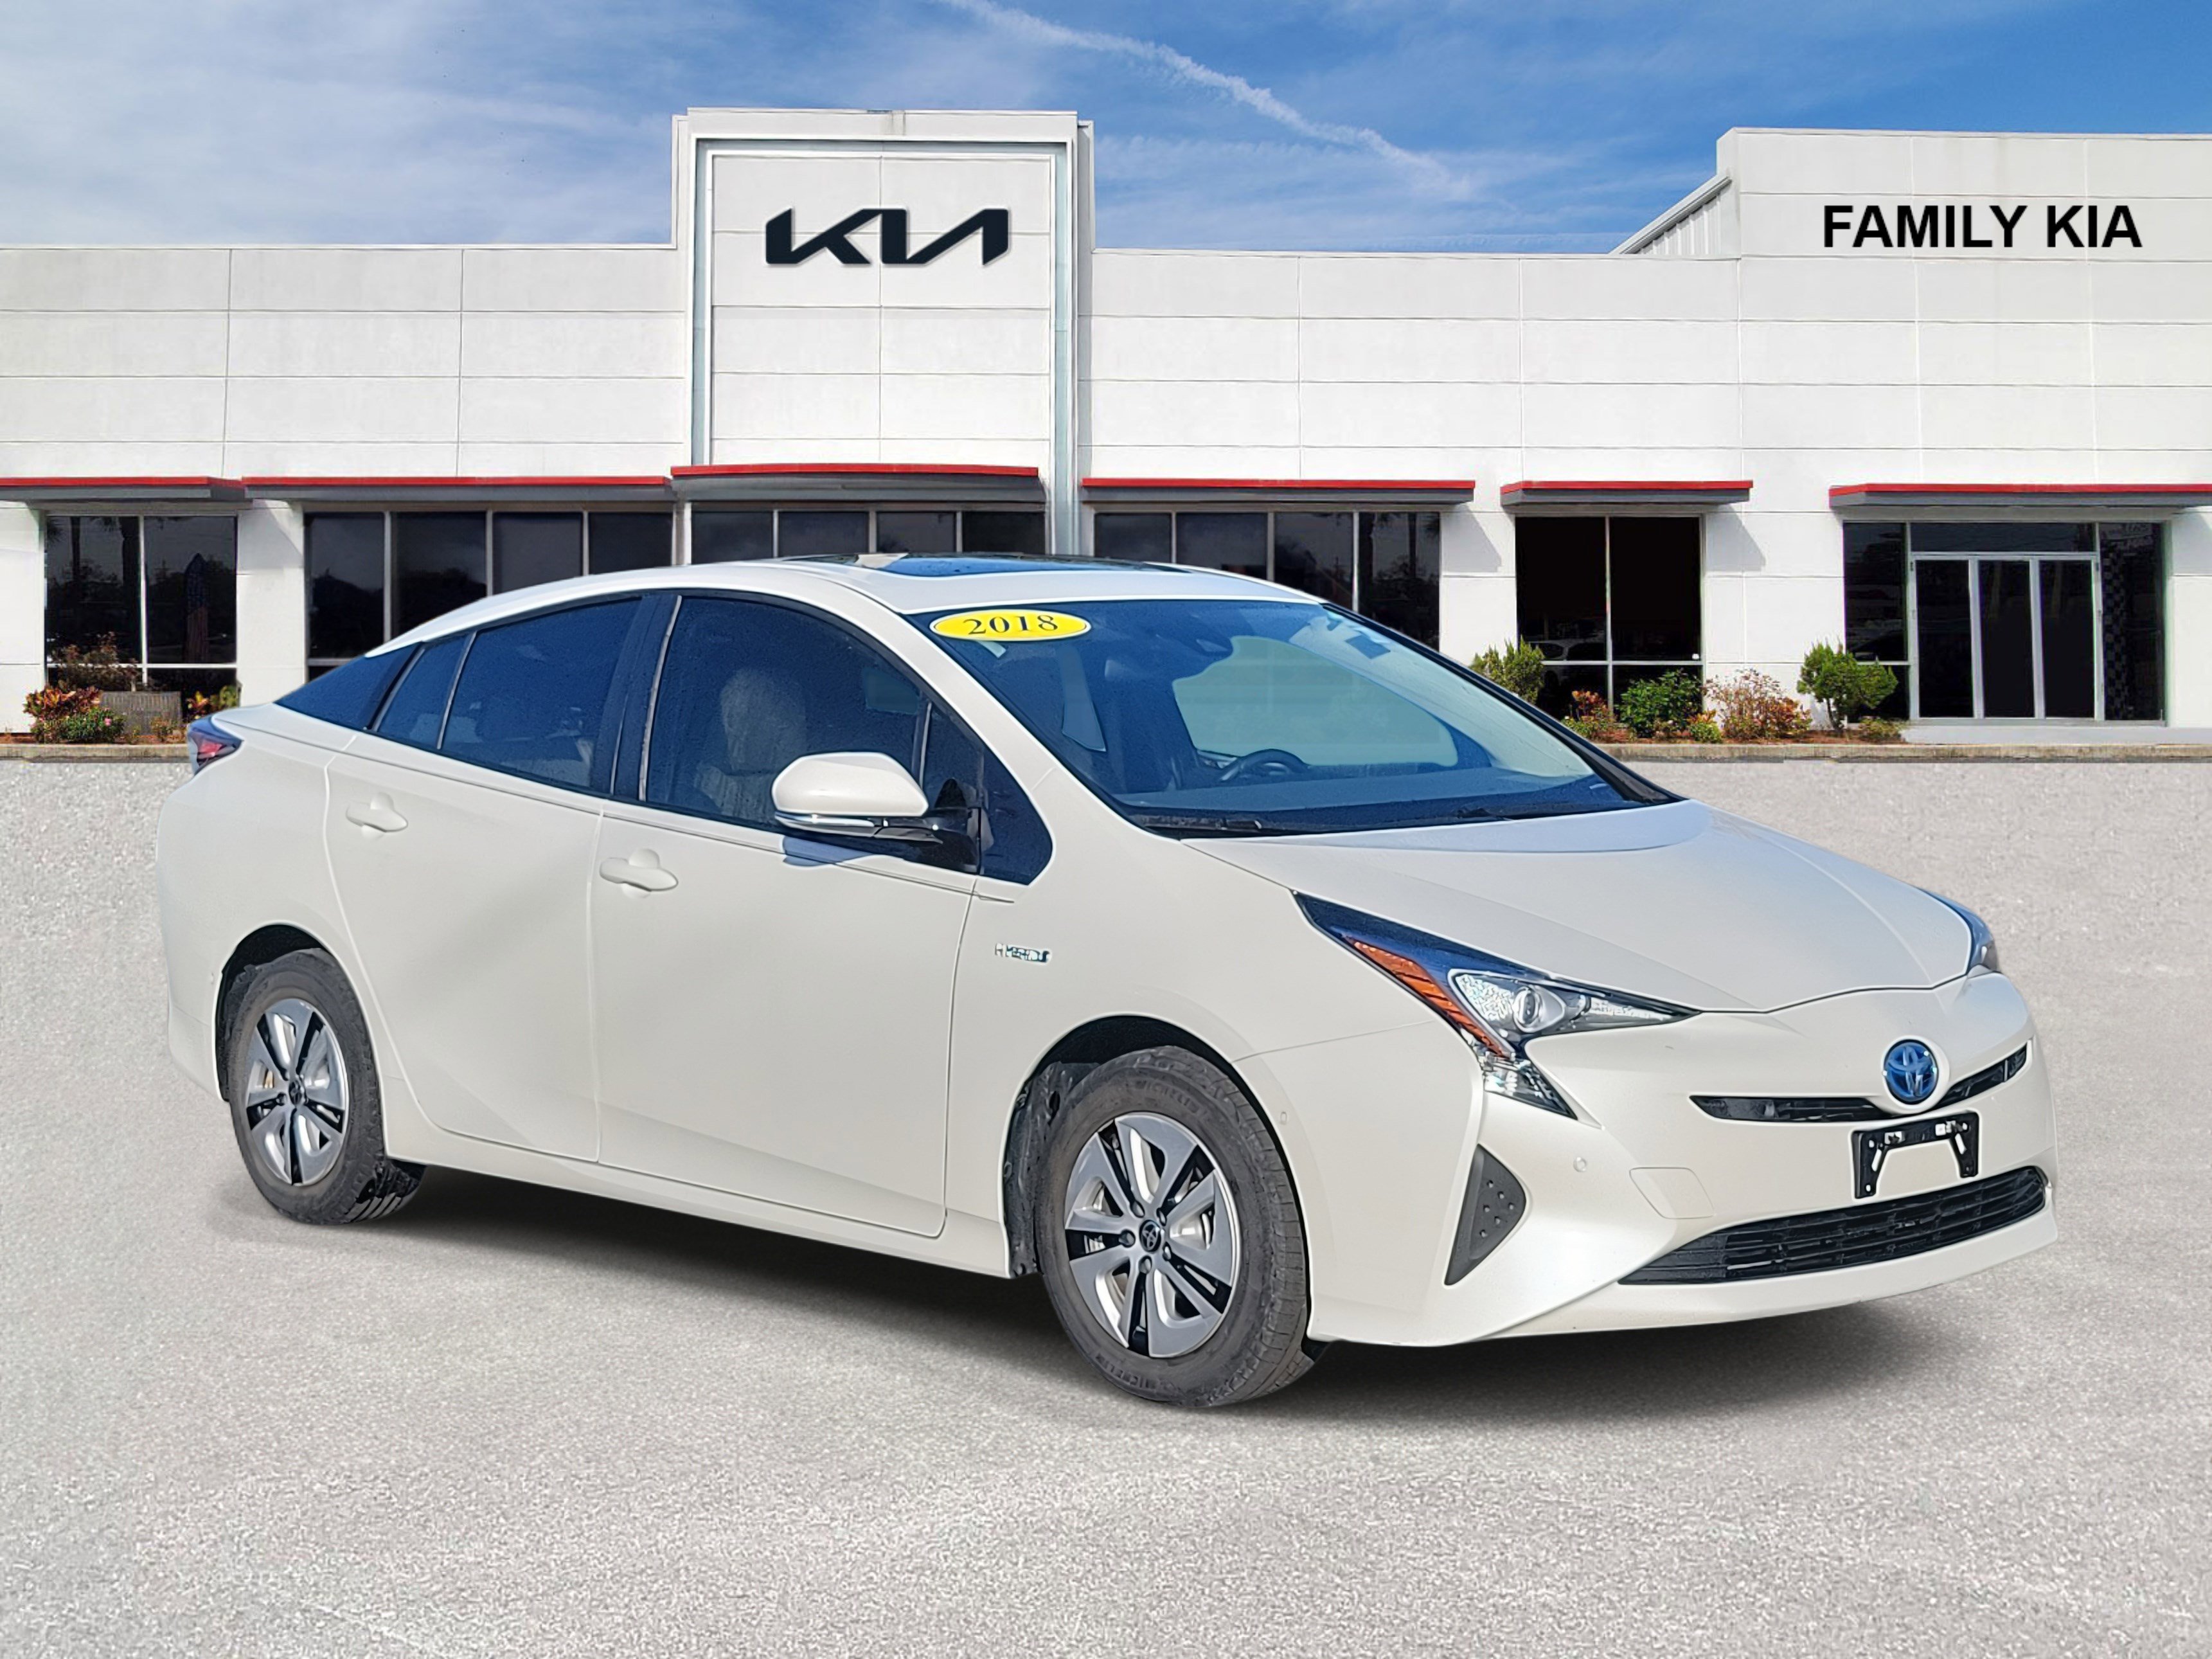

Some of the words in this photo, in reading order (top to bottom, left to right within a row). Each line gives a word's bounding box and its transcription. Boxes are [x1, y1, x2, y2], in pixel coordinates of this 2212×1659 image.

[765, 208, 1009, 265] KIA
[1824, 205, 2028, 247] FAMILY
[2047, 205, 2143, 247] KIA
[963, 614, 1058, 635] 2018
